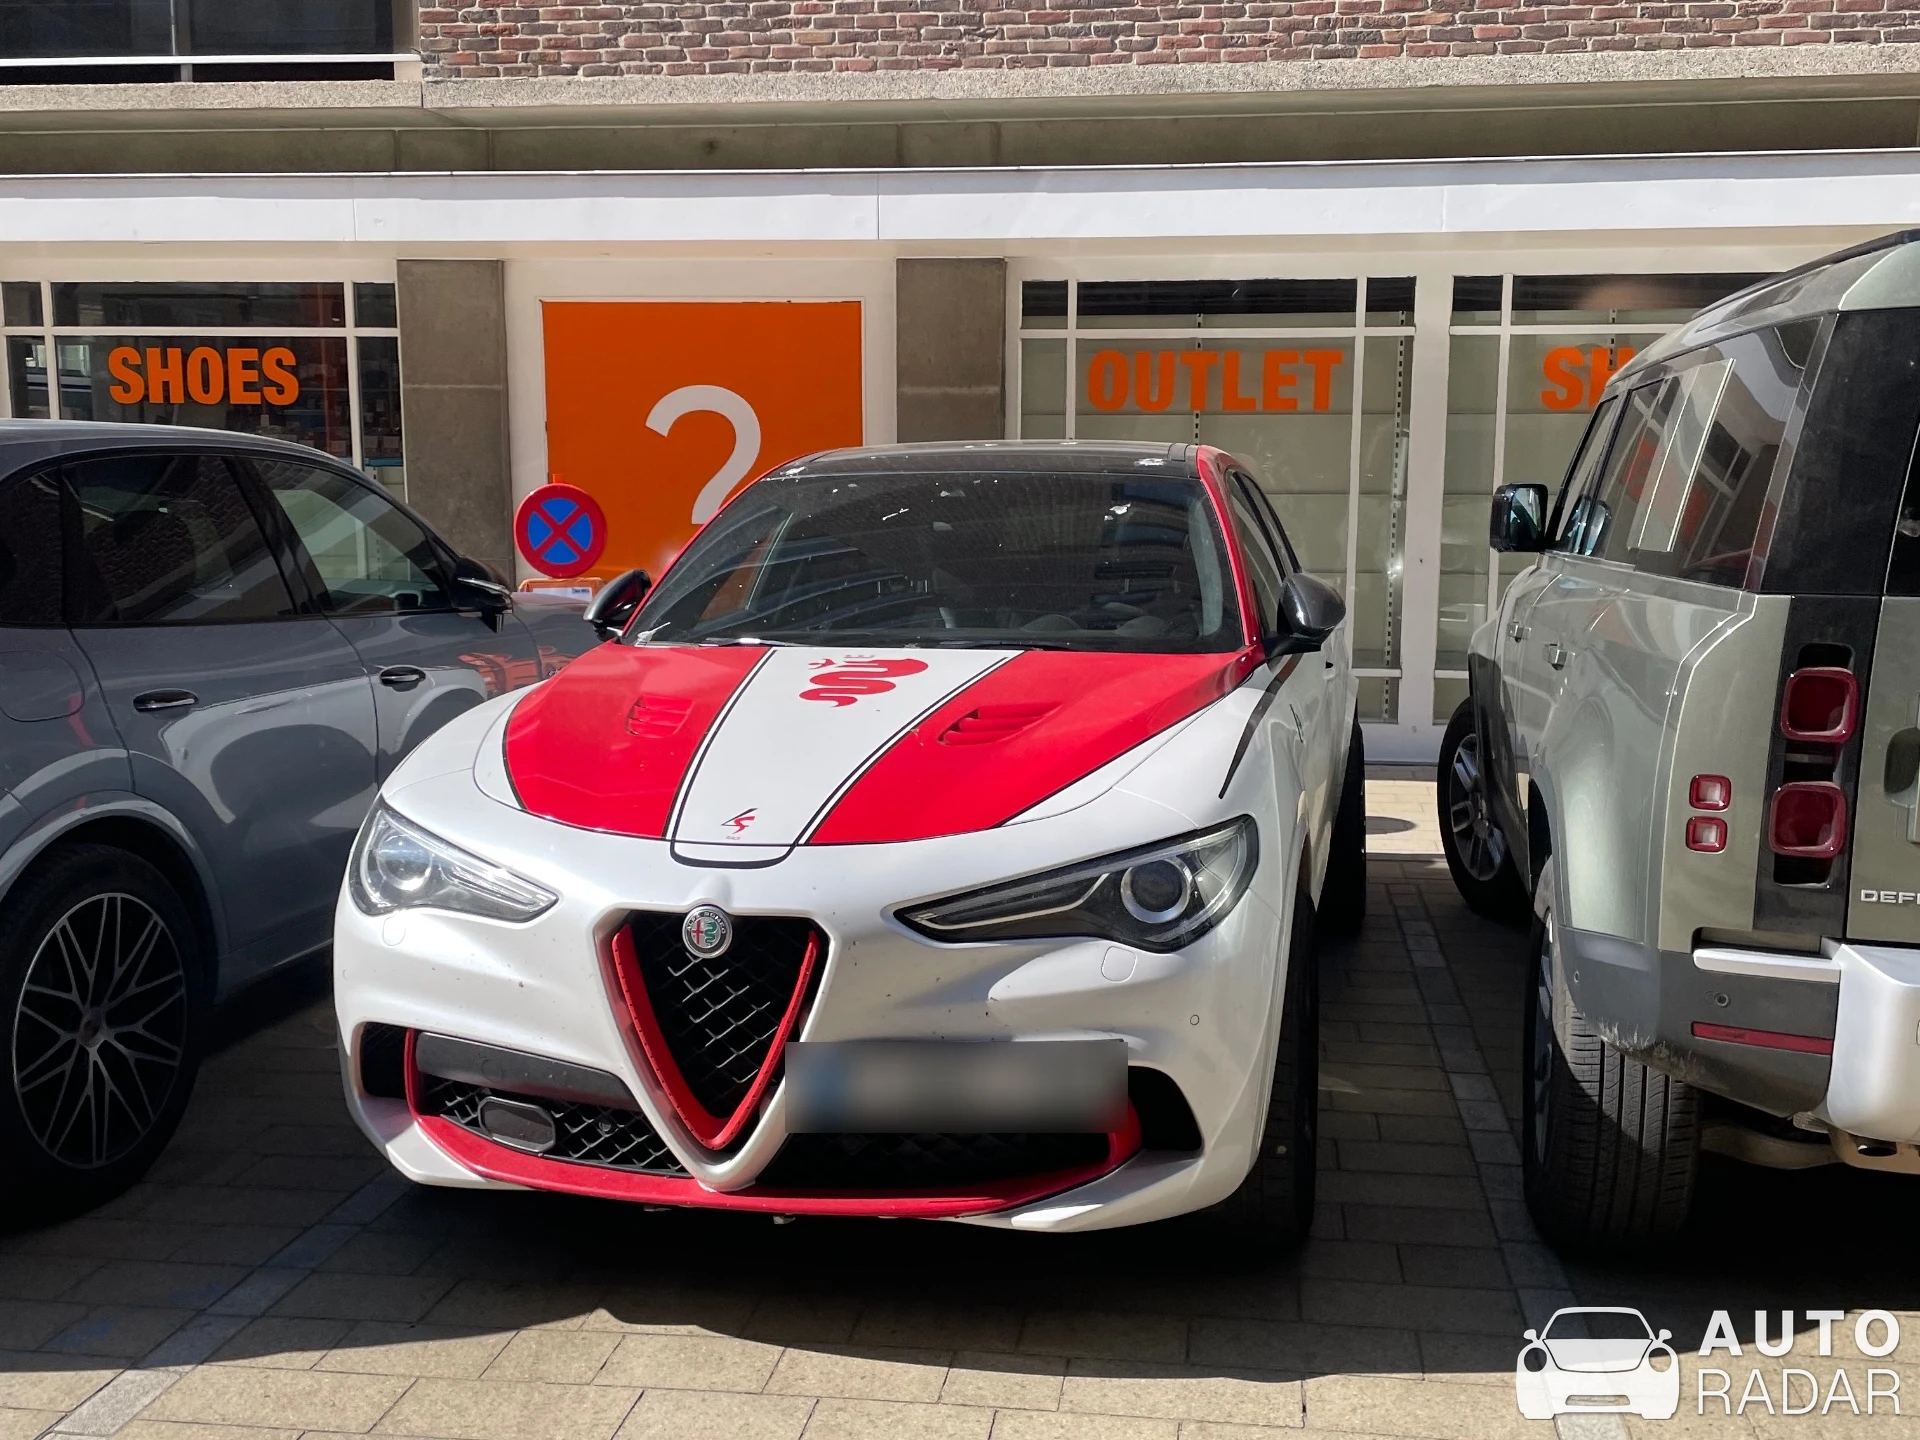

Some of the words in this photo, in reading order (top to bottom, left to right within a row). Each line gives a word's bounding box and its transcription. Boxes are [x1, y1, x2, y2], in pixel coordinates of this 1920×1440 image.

[108, 346, 299, 406] SHOES
[1087, 349, 1343, 411] OUTLET
[1860, 889, 1920, 905] DEF
